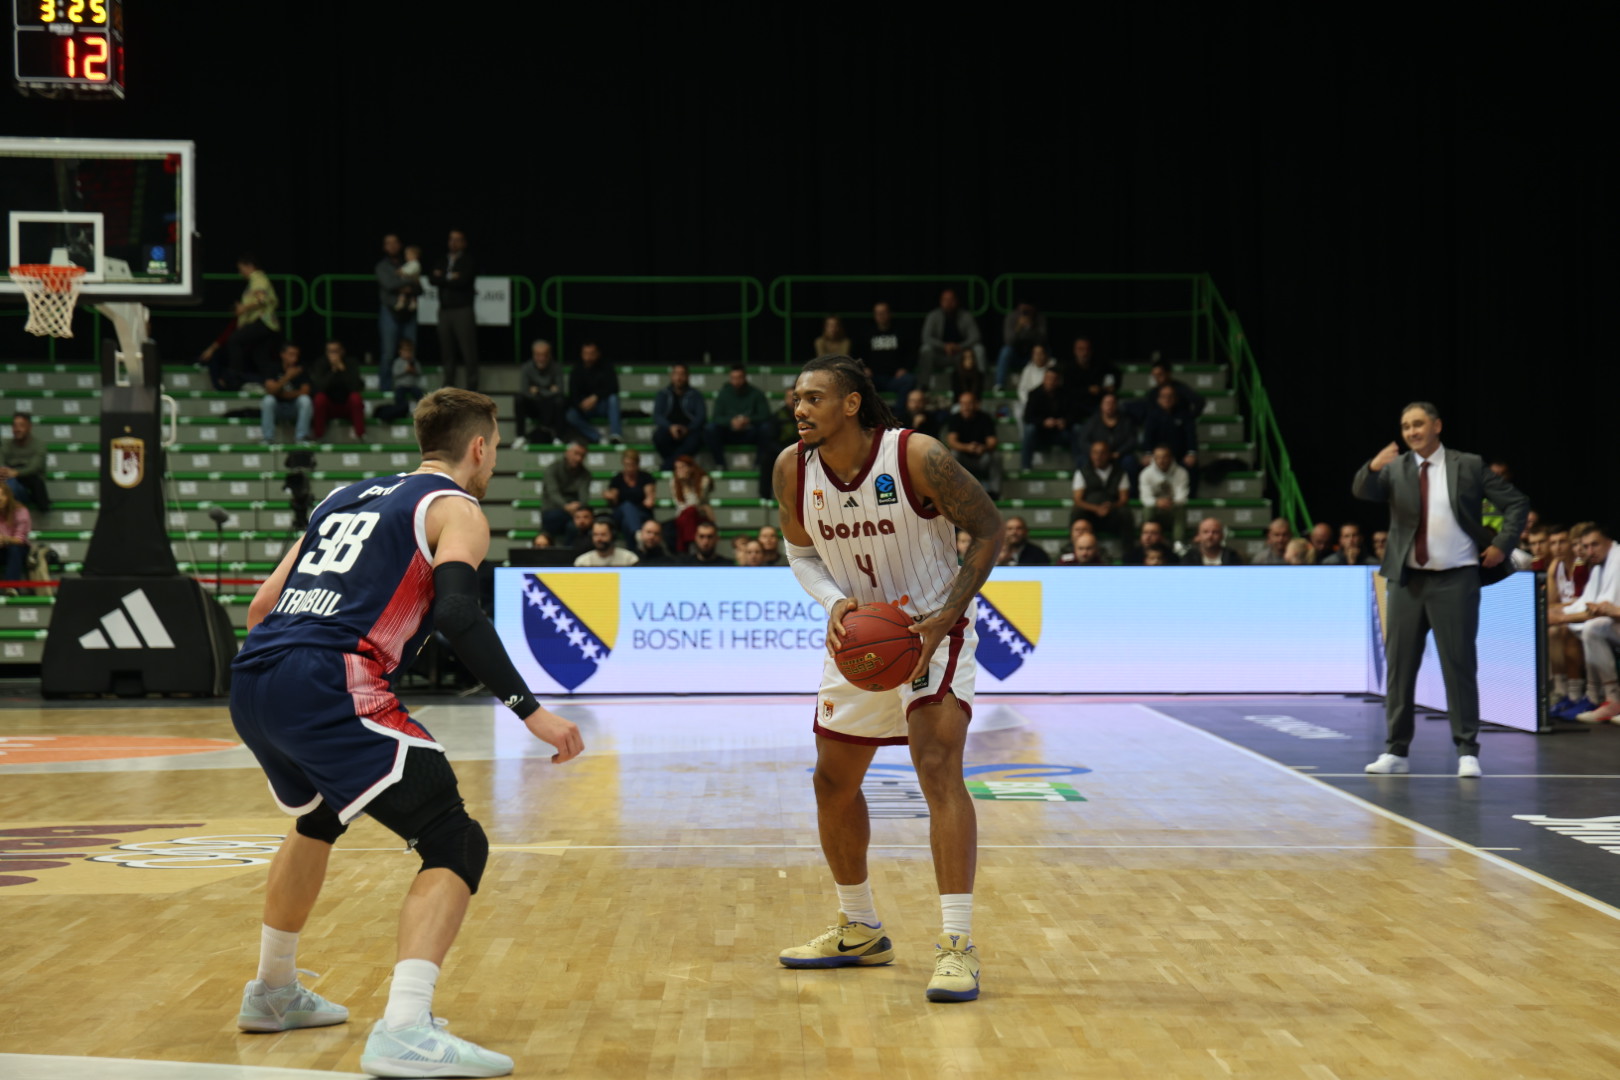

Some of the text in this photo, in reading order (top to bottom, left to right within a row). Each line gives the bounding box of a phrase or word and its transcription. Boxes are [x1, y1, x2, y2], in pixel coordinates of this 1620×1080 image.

[40, 0, 107, 23] 3:25
[68, 37, 107, 80] 12
[818, 519, 895, 540] bosna
[298, 511, 380, 576] 38
[632, 601, 713, 621] VLADA
[633, 628, 712, 649] BOSNE
[719, 629, 725, 649] I
[731, 628, 825, 649] HERCEG
[984, 781, 1066, 801] BKT
